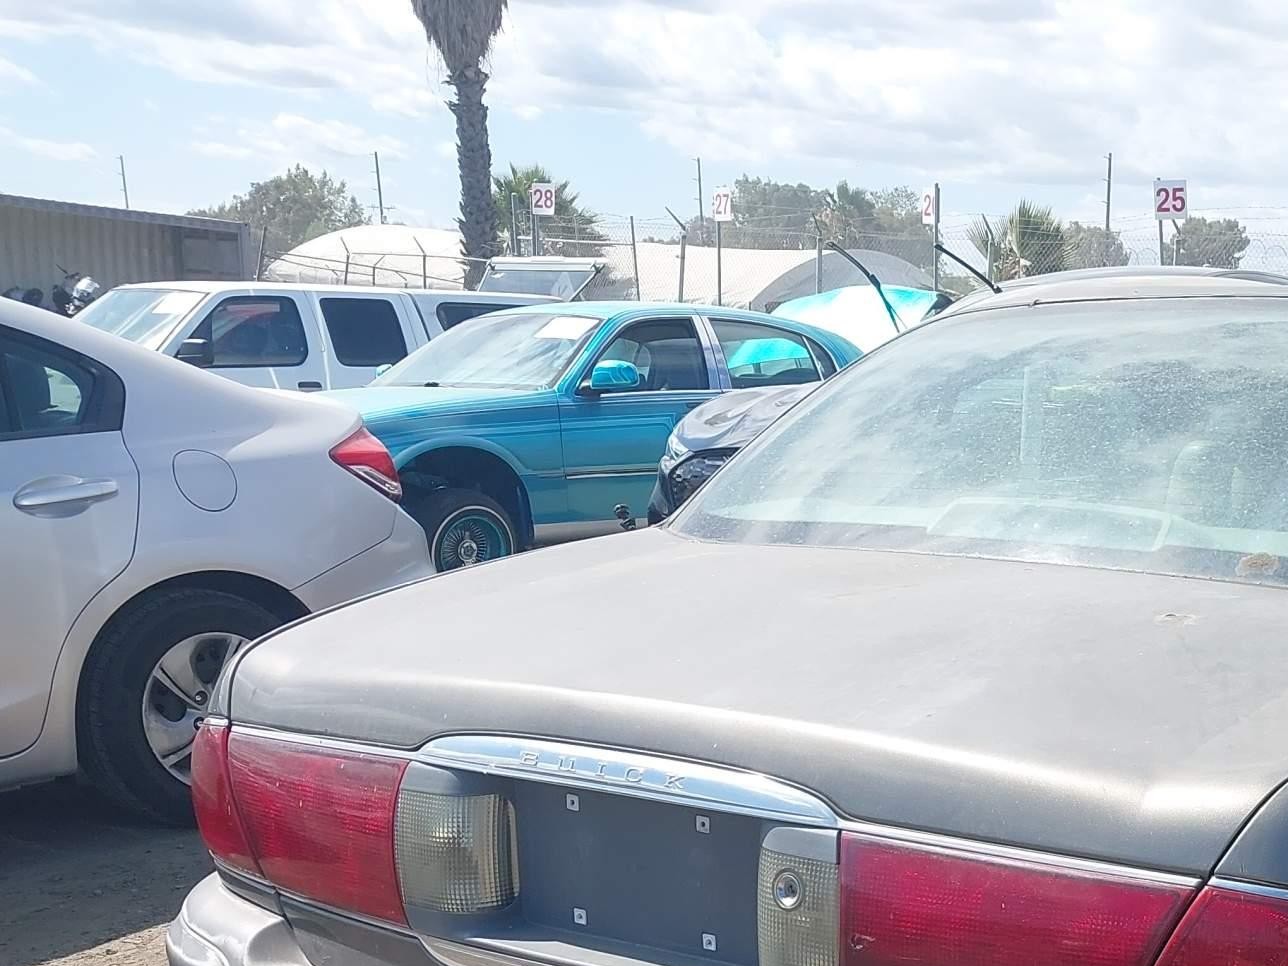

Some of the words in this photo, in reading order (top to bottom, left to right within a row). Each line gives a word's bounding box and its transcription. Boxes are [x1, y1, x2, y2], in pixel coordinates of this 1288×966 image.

[533, 188, 554, 209] 28
[715, 193, 730, 215] 27
[923, 193, 935, 217] 2
[1156, 187, 1186, 213] 25
[519, 749, 686, 791] BUICK
